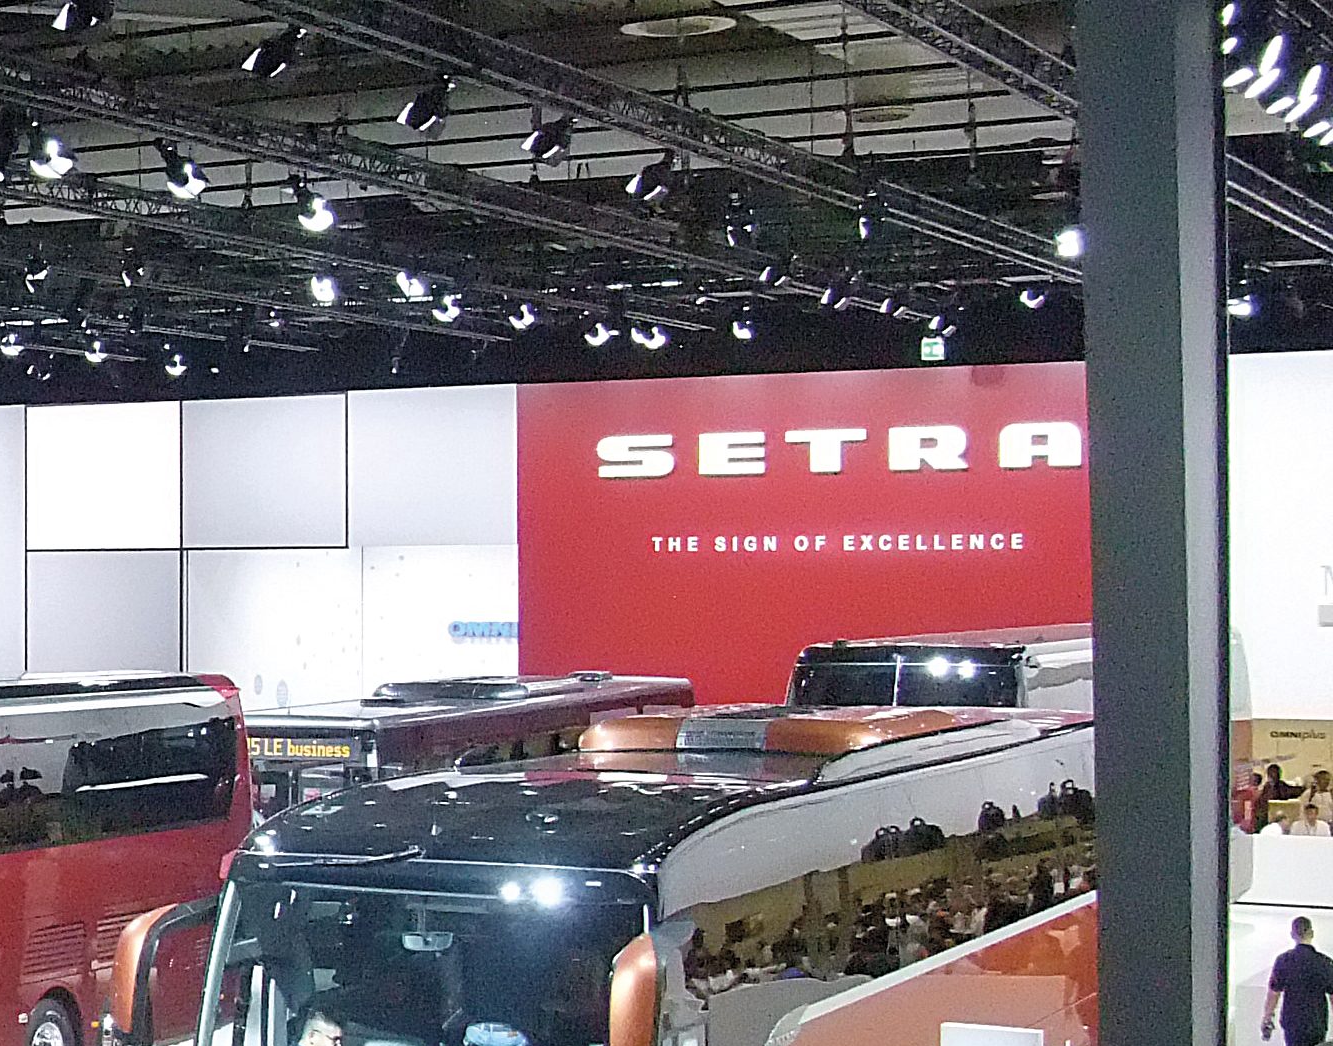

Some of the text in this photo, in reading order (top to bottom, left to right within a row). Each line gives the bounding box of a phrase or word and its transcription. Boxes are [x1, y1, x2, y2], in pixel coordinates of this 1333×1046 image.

[596, 421, 1083, 478] SETRA
[651, 532, 1026, 552] THE SIGN OF EXCELLENCE
[264, 738, 284, 756] LE
[287, 738, 351, 758] business
